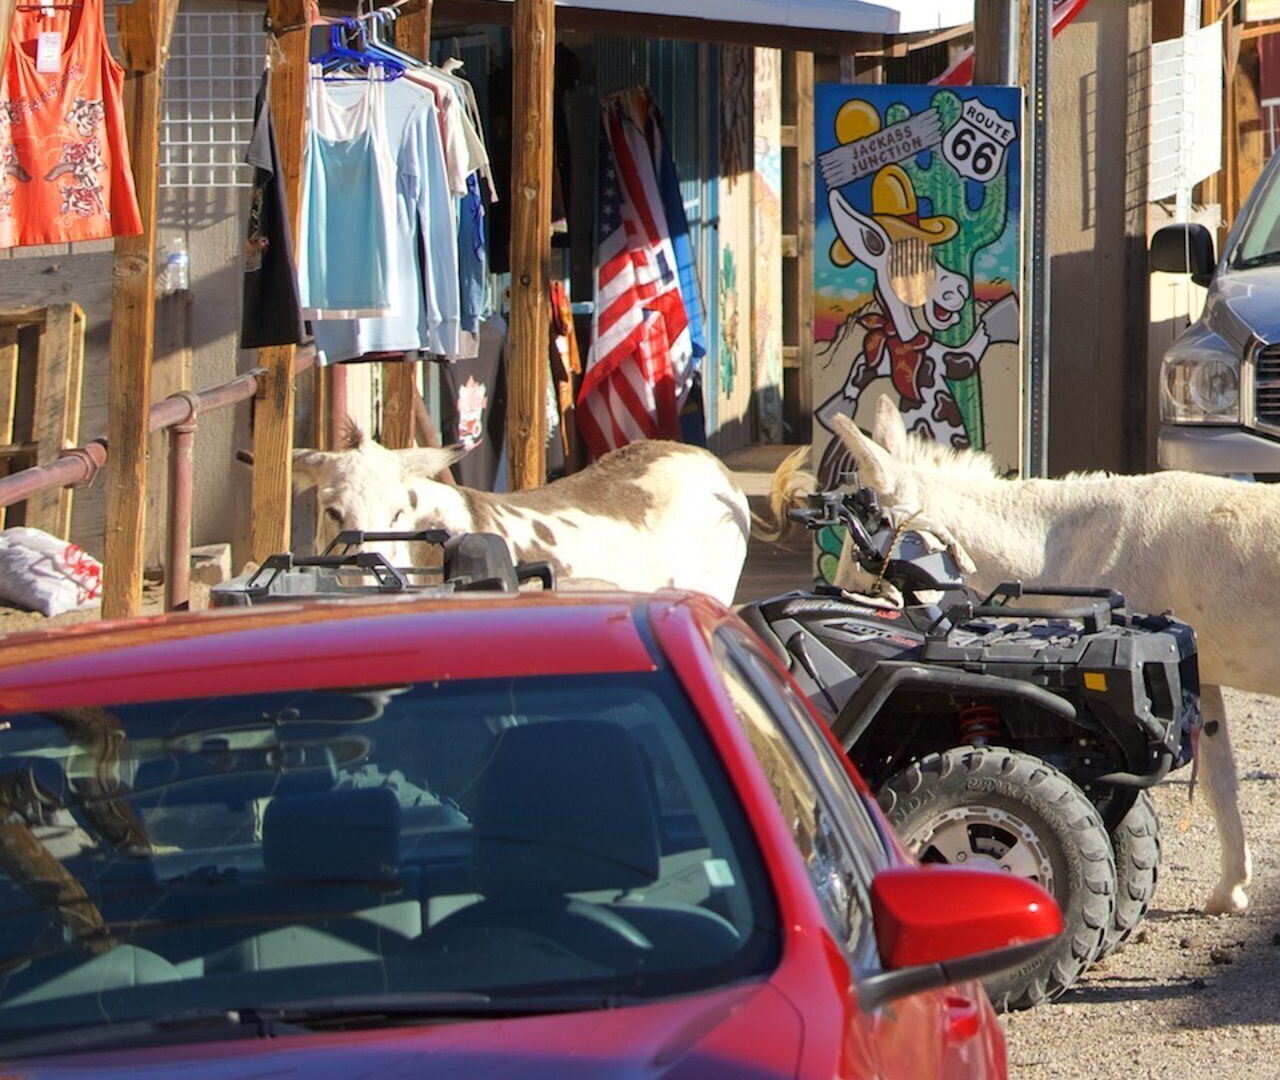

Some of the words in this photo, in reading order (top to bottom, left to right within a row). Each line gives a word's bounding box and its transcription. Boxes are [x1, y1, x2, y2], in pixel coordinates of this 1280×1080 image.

[966, 105, 1011, 141] ROUTE
[851, 137, 922, 175] JUNCTION
[852, 126, 913, 160] JACKASS
[952, 128, 997, 175] 66
